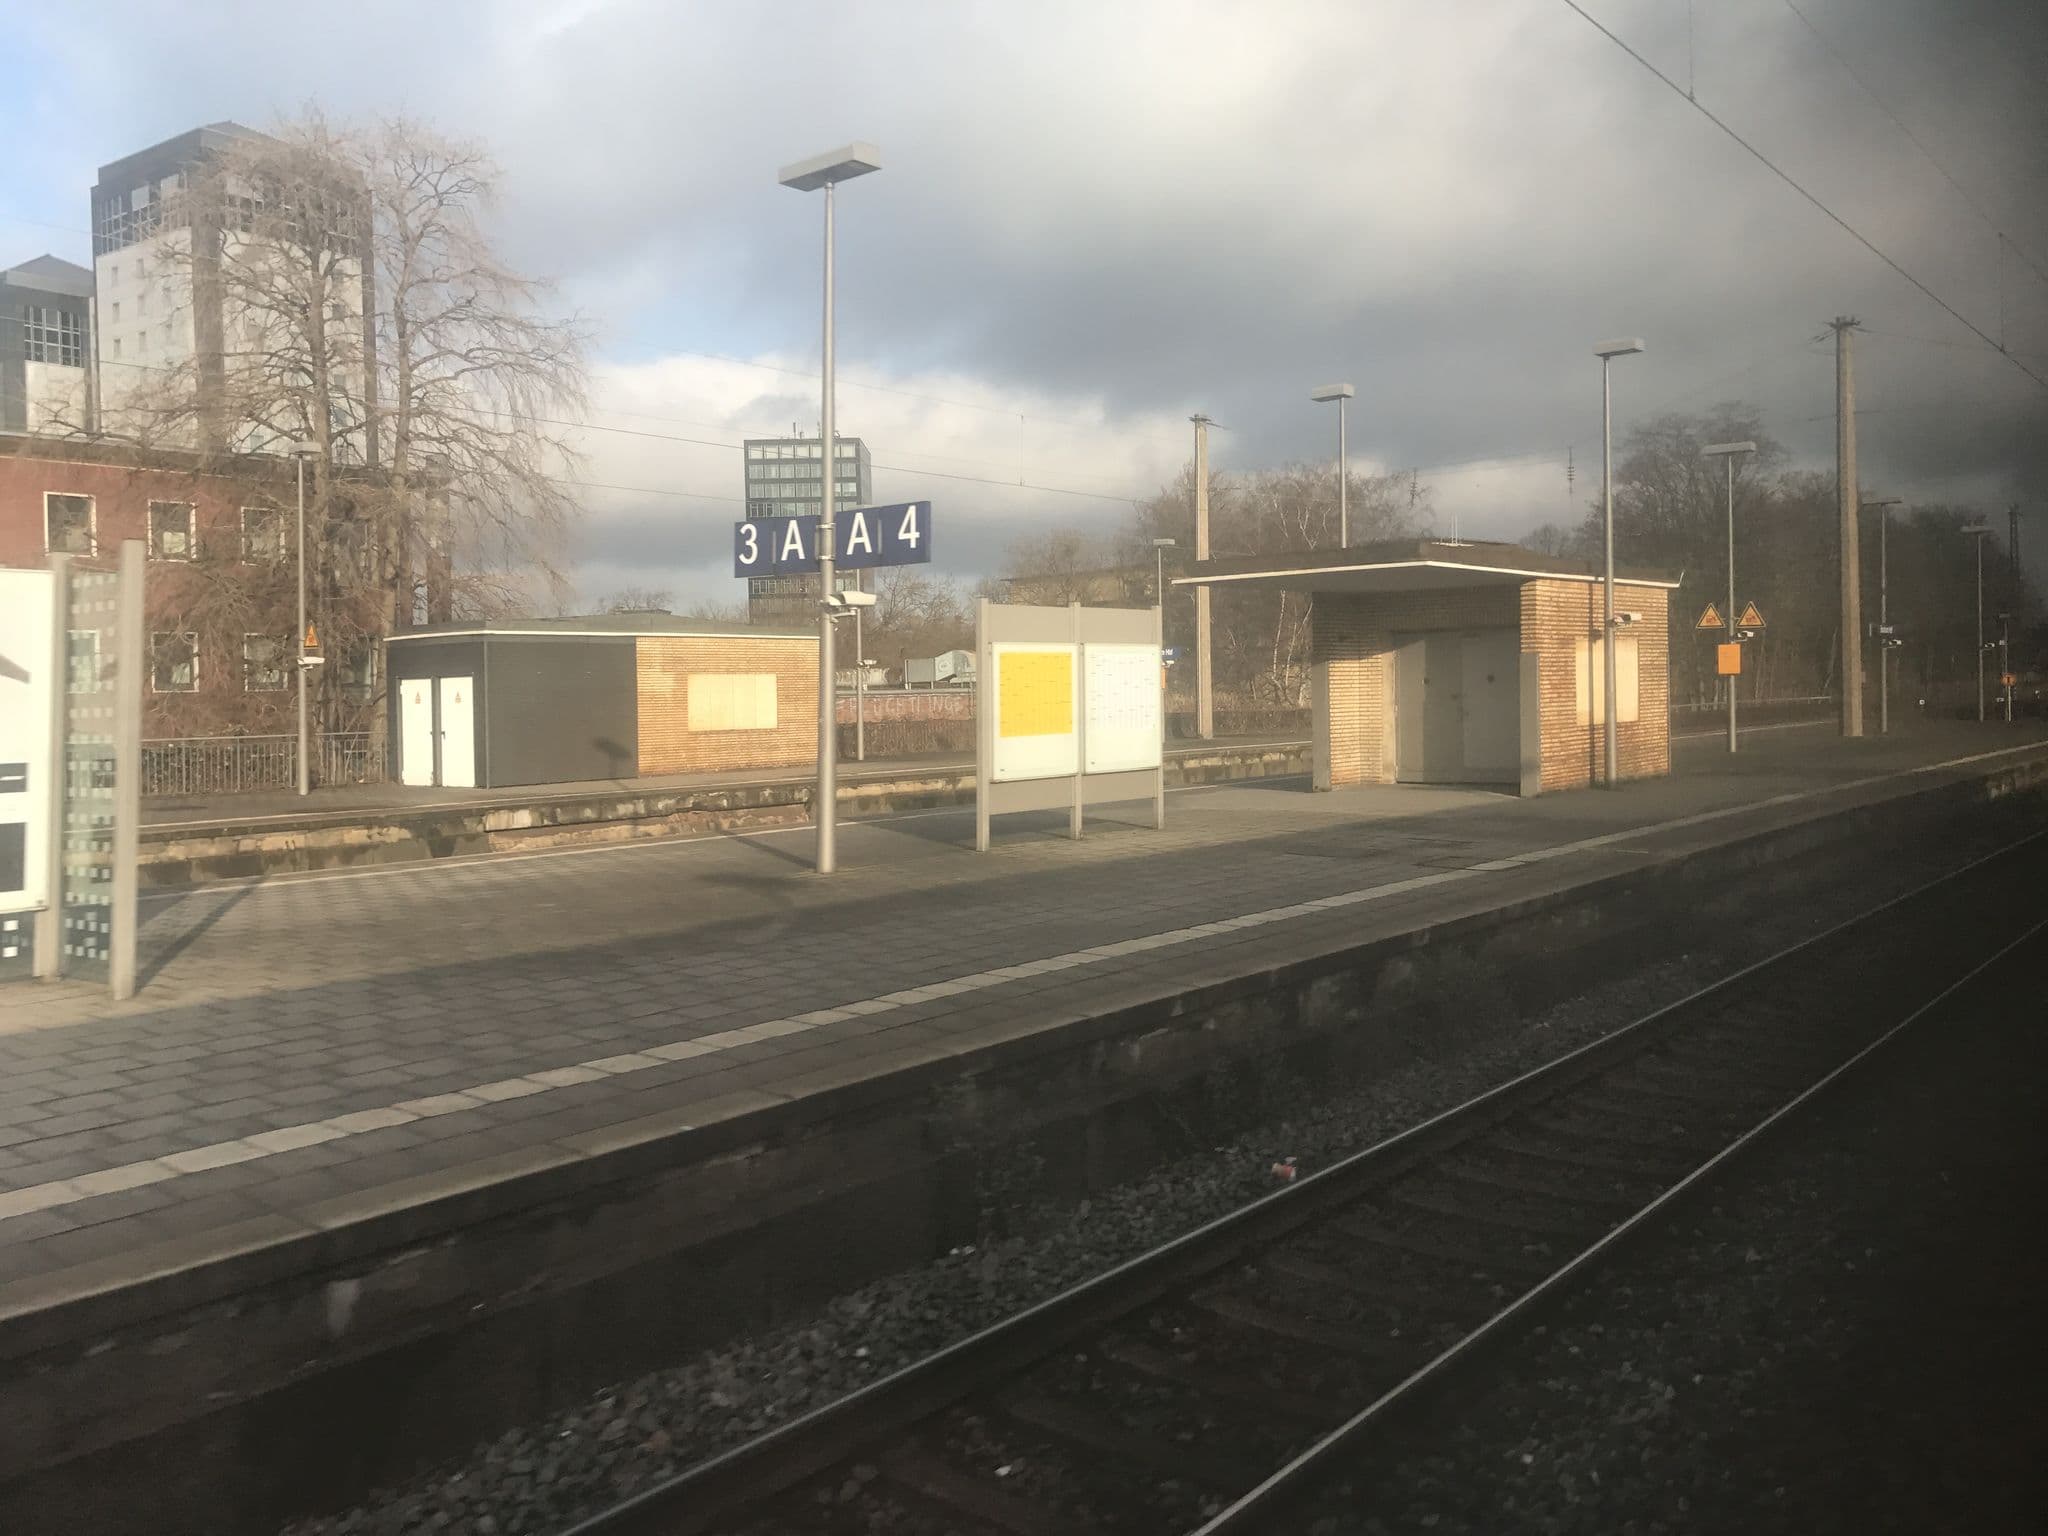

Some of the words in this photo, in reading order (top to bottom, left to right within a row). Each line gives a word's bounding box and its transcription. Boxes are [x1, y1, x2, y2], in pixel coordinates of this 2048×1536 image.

[738, 523, 759, 564] 3
[780, 519, 806, 561] A
[846, 512, 872, 555] A
[898, 504, 920, 549] 4
